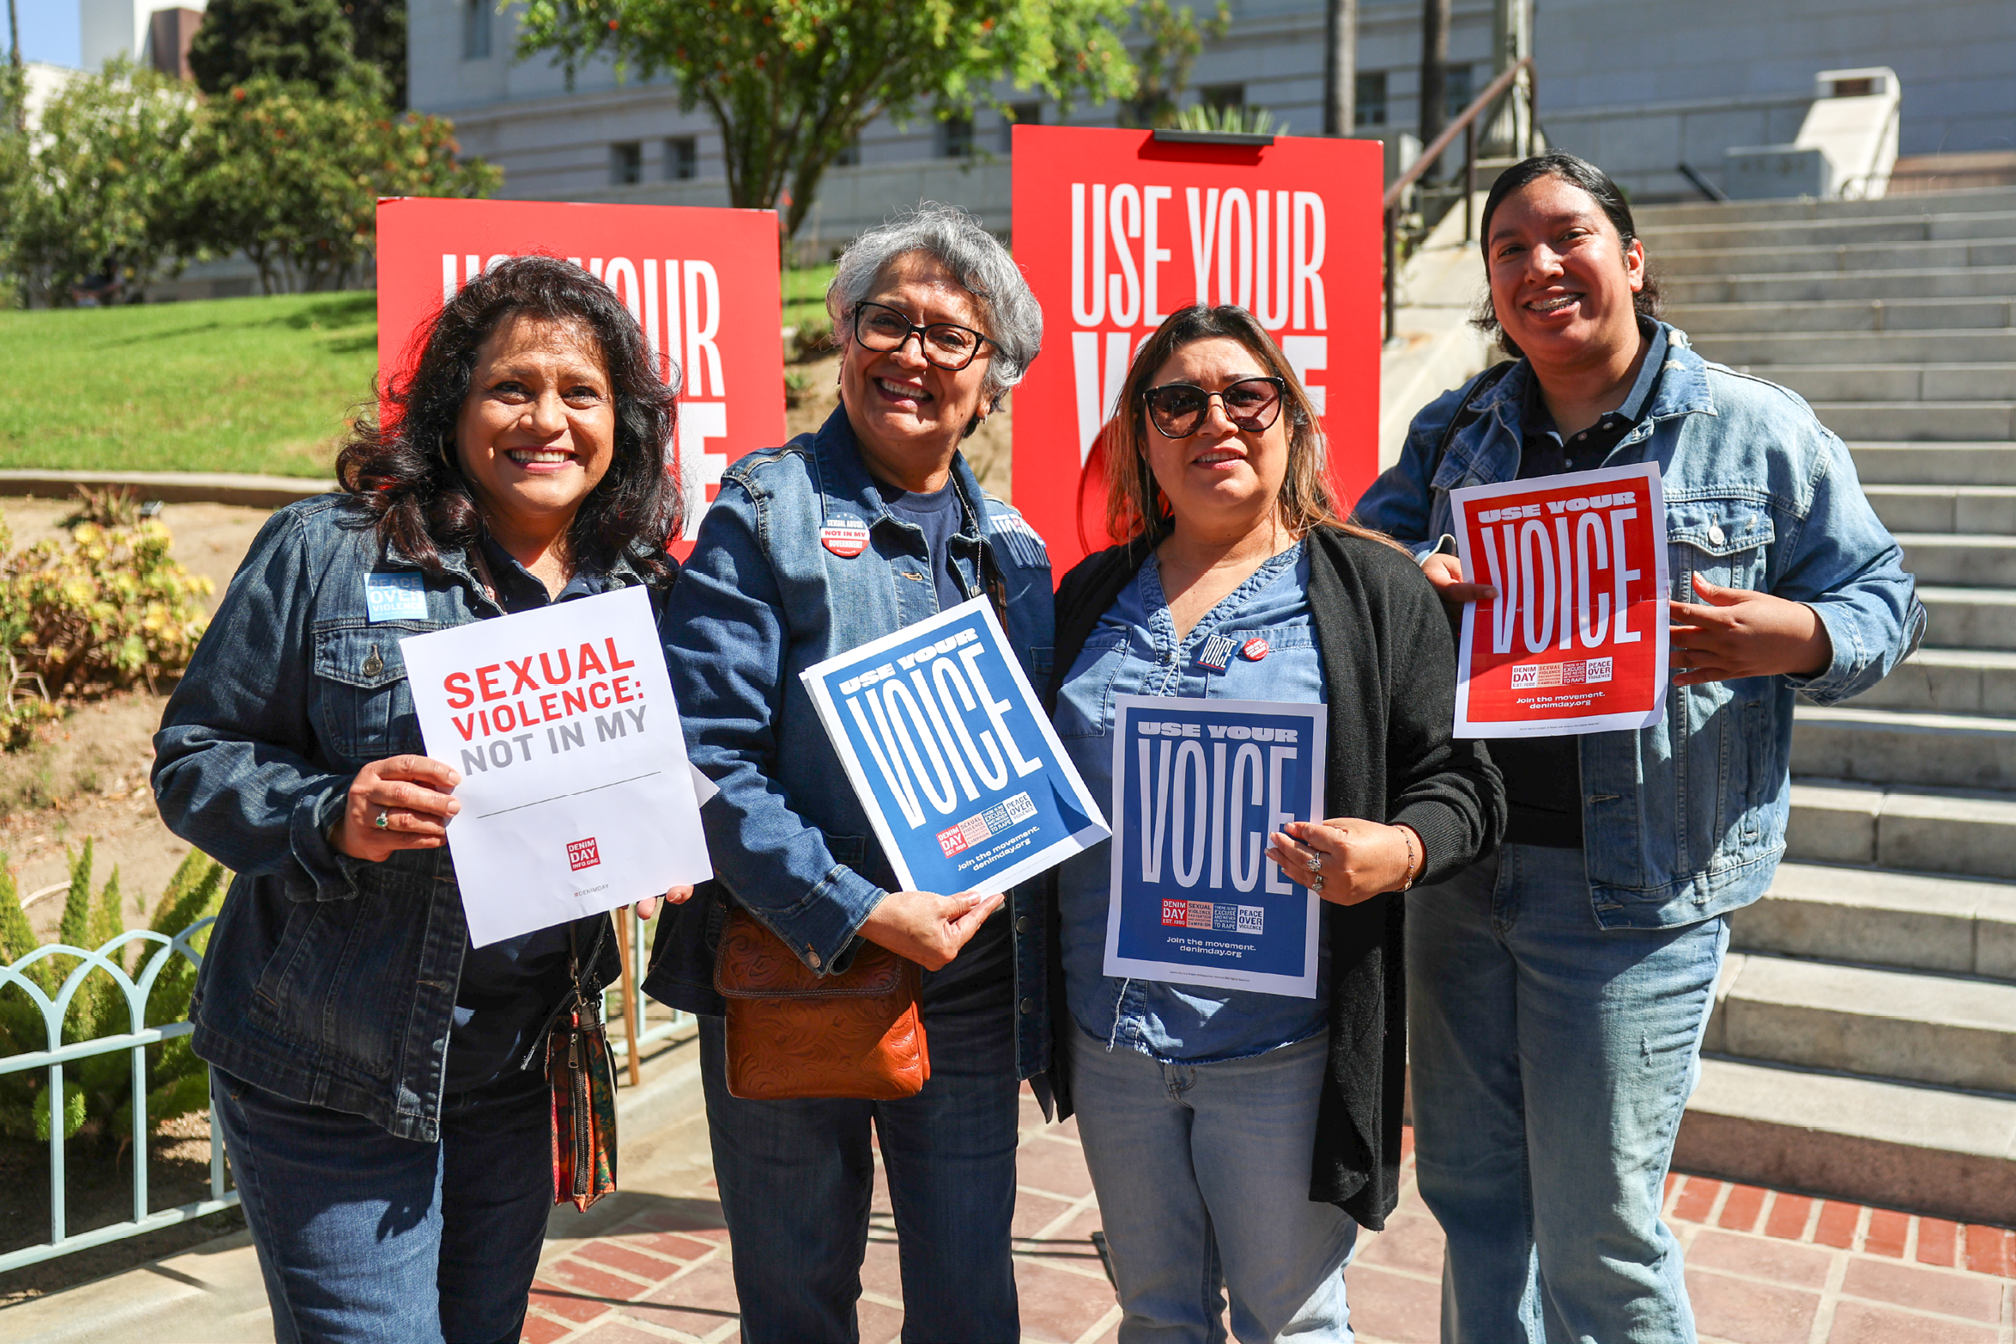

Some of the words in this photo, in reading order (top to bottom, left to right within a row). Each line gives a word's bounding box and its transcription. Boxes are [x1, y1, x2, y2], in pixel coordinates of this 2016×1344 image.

[1071, 183, 1172, 328] USE
[1185, 187, 1328, 331] YOUR
[1478, 503, 1541, 524] USE
[1546, 491, 1636, 515] YOUR
[369, 577, 420, 590] PEACE
[1480, 507, 1642, 654] VOICE
[369, 588, 425, 604] OVER
[372, 602, 425, 612] VIOLENCE
[1200, 636, 1237, 669] VOICE
[838, 662, 897, 696] USE
[896, 627, 980, 670] YOUR
[1588, 660, 1610, 668] PEACE
[443, 636, 636, 710] SEXUAL
[1513, 673, 1536, 682] DAY
[1588, 667, 1610, 676] OVER
[1555, 691, 1605, 701] movement.
[450, 674, 646, 742] VIOLENCE:
[1529, 700, 1592, 709] denimday.org
[845, 641, 1044, 830] VOICE
[1137, 721, 1201, 738] USE
[1206, 725, 1298, 743] YOUR
[460, 733, 534, 776] NOT
[546, 721, 586, 755] IN
[594, 704, 647, 743] MY
[1006, 794, 1029, 809] PEACE
[1009, 800, 1033, 816] OVER
[960, 817, 982, 829] SEXUAL
[1137, 738, 1298, 896] VOICE
[938, 826, 960, 841] DENIM
[963, 821, 984, 834] VIOLENCE
[568, 839, 595, 852] DENIM
[941, 833, 963, 851] DAY
[957, 859, 976, 871] Join
[975, 850, 992, 862] the
[992, 825, 1040, 853] movement.
[570, 847, 595, 863] DAY
[972, 838, 1031, 871] denimday.org
[574, 883, 609, 897] #DENIMDAY
[1163, 900, 1186, 908] DENIM
[1163, 908, 1185, 919] DAY
[1239, 909, 1262, 918] PEACE
[1239, 916, 1262, 925] OVER
[1166, 936, 1185, 944] Join
[1187, 938, 1203, 946] the
[1205, 940, 1256, 951] movement.
[1180, 945, 1242, 958] denimday.org
